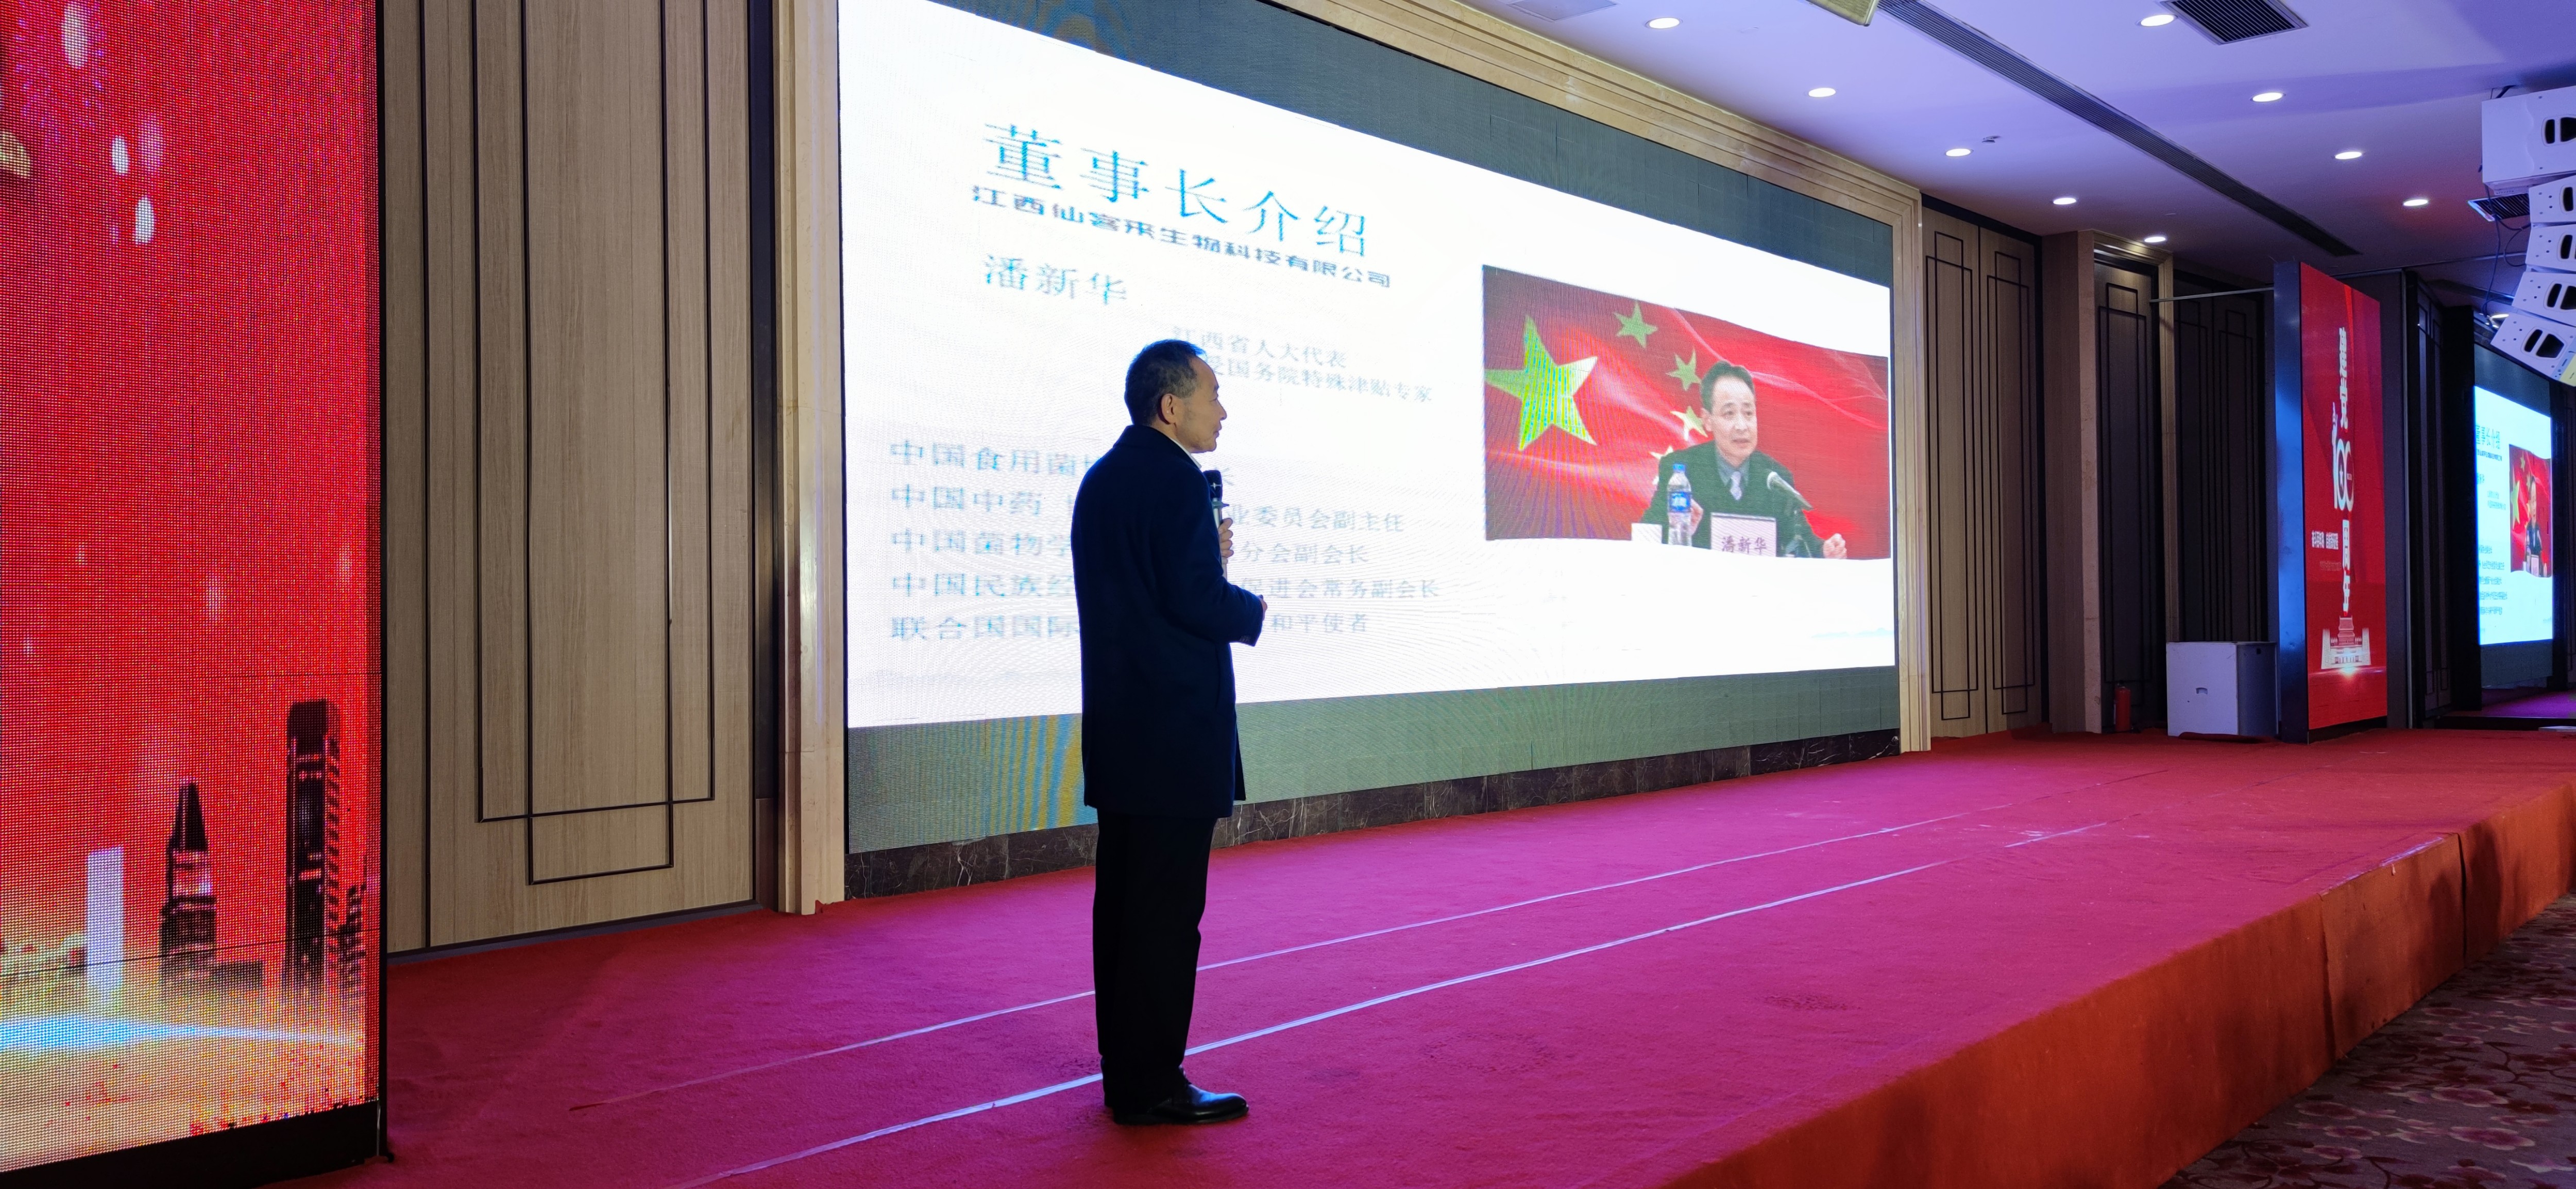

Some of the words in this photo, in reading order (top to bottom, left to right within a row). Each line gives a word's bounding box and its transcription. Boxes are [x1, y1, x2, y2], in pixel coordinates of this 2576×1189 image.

[984, 123, 1367, 257] 董事长介绍
[972, 185, 1392, 289] 江西仙客来生物科技有限公司
[984, 254, 1127, 306] 潘新华
[1240, 540, 1368, 564] 分会副会长
[1722, 535, 1766, 555] 潘新华
[1270, 612, 1368, 634] 和平使者
